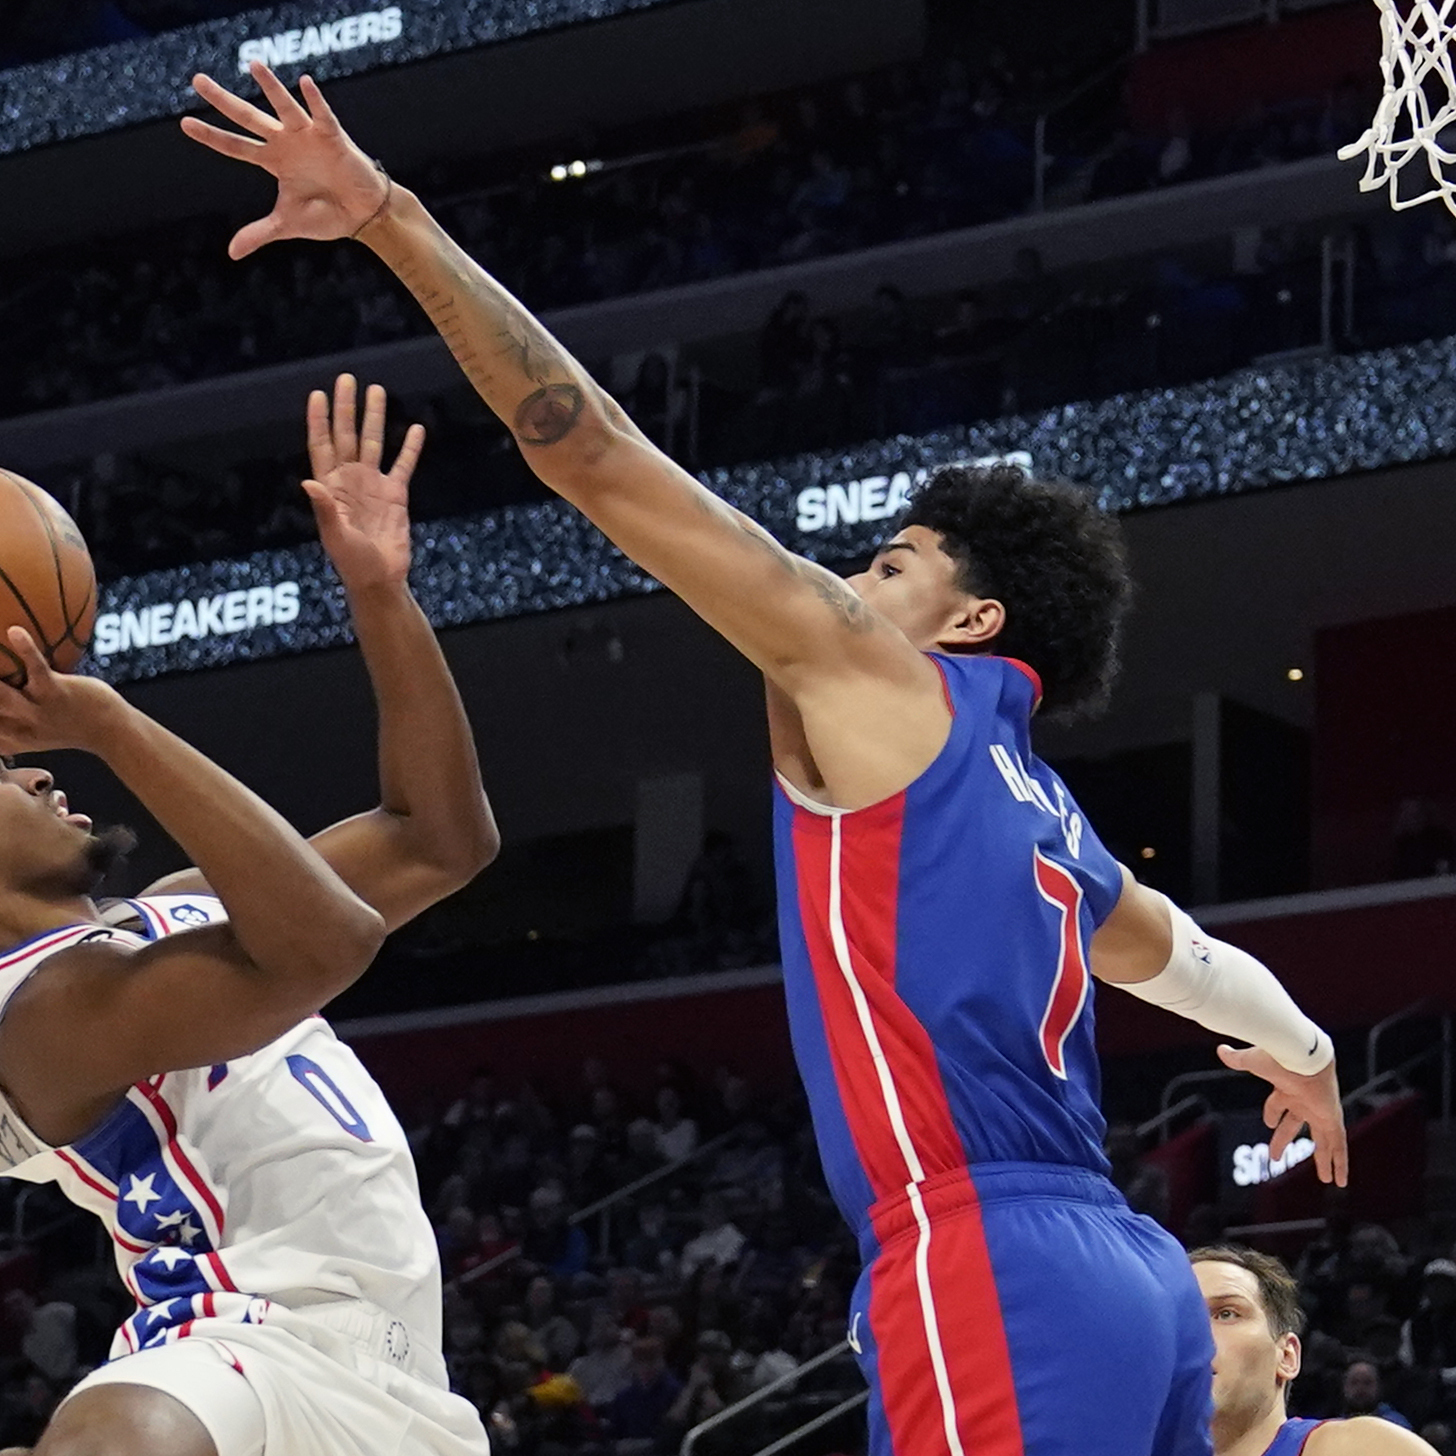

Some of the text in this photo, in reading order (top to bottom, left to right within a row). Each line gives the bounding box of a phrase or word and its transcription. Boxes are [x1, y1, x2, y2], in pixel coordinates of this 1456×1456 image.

[238, 7, 402, 74] SNEAKERS
[796, 450, 1034, 532] SNEA
[96, 581, 299, 656] SNEAKERS
[285, 1053, 375, 1143] 0
